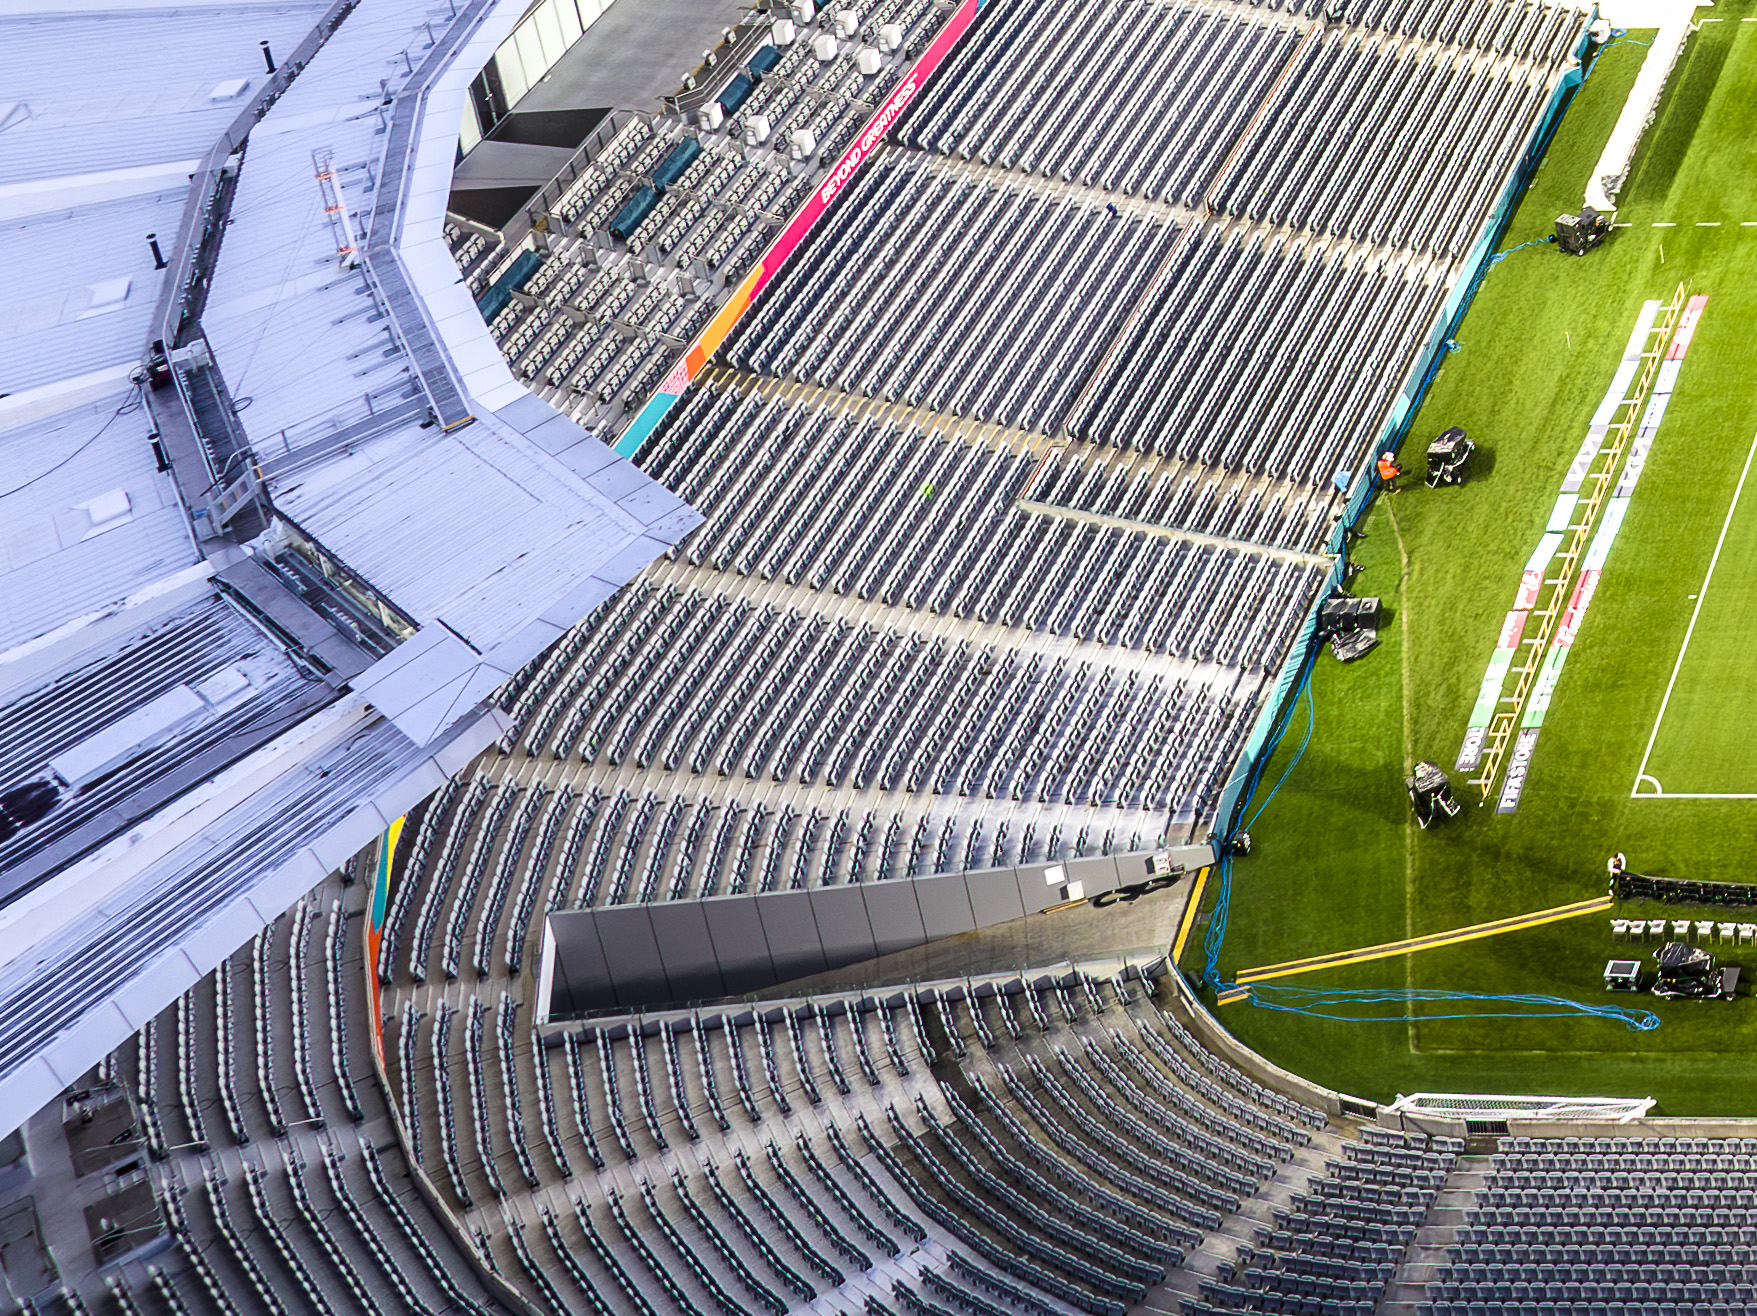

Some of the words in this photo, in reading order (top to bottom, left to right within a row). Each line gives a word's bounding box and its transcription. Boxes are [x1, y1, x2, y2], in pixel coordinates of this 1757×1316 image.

[821, 146, 861, 203] BEYOND
[1500, 773, 1521, 808] FIFA
[1512, 733, 1538, 776] STORE
